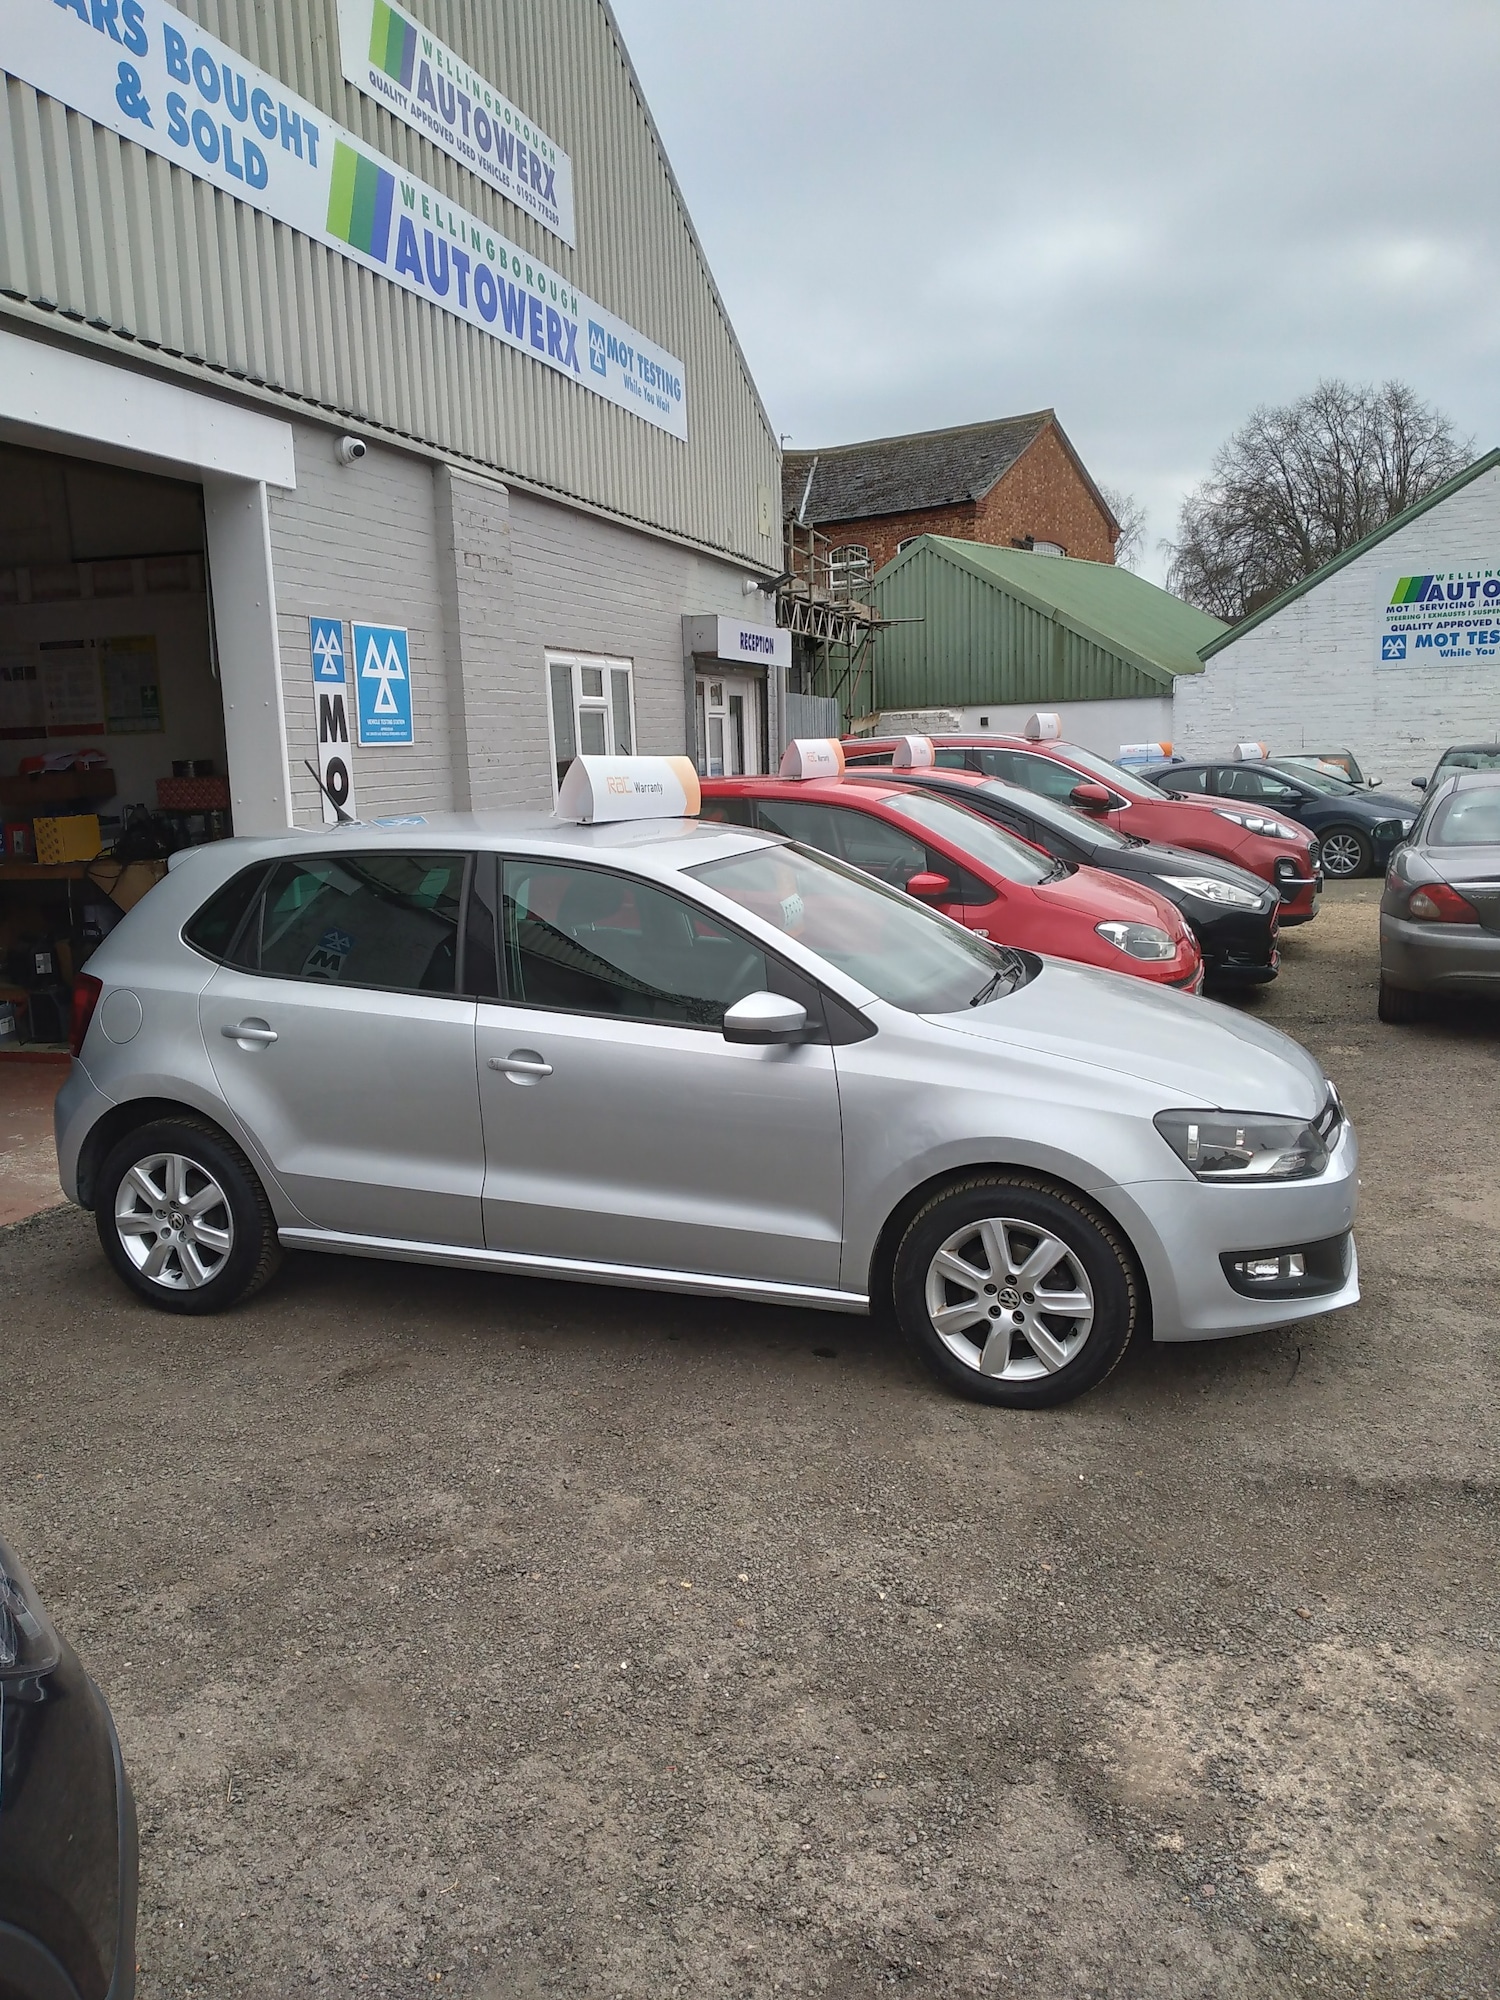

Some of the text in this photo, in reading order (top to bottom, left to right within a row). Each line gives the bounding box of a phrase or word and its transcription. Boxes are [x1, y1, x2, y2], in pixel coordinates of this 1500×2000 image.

[163, 22, 319, 169] BOUGHT
[422, 35, 556, 165] WELLINGBOROUGH
[115, 61, 269, 190] & SOLD
[369, 70, 408, 110] QUALITY
[410, 100, 454, 144] APPROVED
[457, 136, 475, 162] USED
[477, 152, 510, 188] VEHICLES
[516, 184, 536, 208] 01933
[417, 59, 557, 208] AUTOWERX
[400, 180, 578, 317] WELLINGBOROUGH
[395, 214, 580, 373] AUTOWERX
[607, 333, 681, 402] MOT TESTING
[623, 373, 670, 414] While You Wait
[1386, 605, 1410, 614] MOT
[1419, 601, 1475, 611] SERVICING
[1386, 613, 1421, 622] STEERING
[1428, 610, 1466, 619] EXHAUSTS
[1391, 622, 1433, 632] QUALITY
[1436, 618, 1492, 629] APPROVED
[740, 632, 774, 654] RECEPTION
[1415, 632, 1460, 648] MOT
[1440, 647, 1495, 657] While You
[634, 782, 663, 795] Warranty
